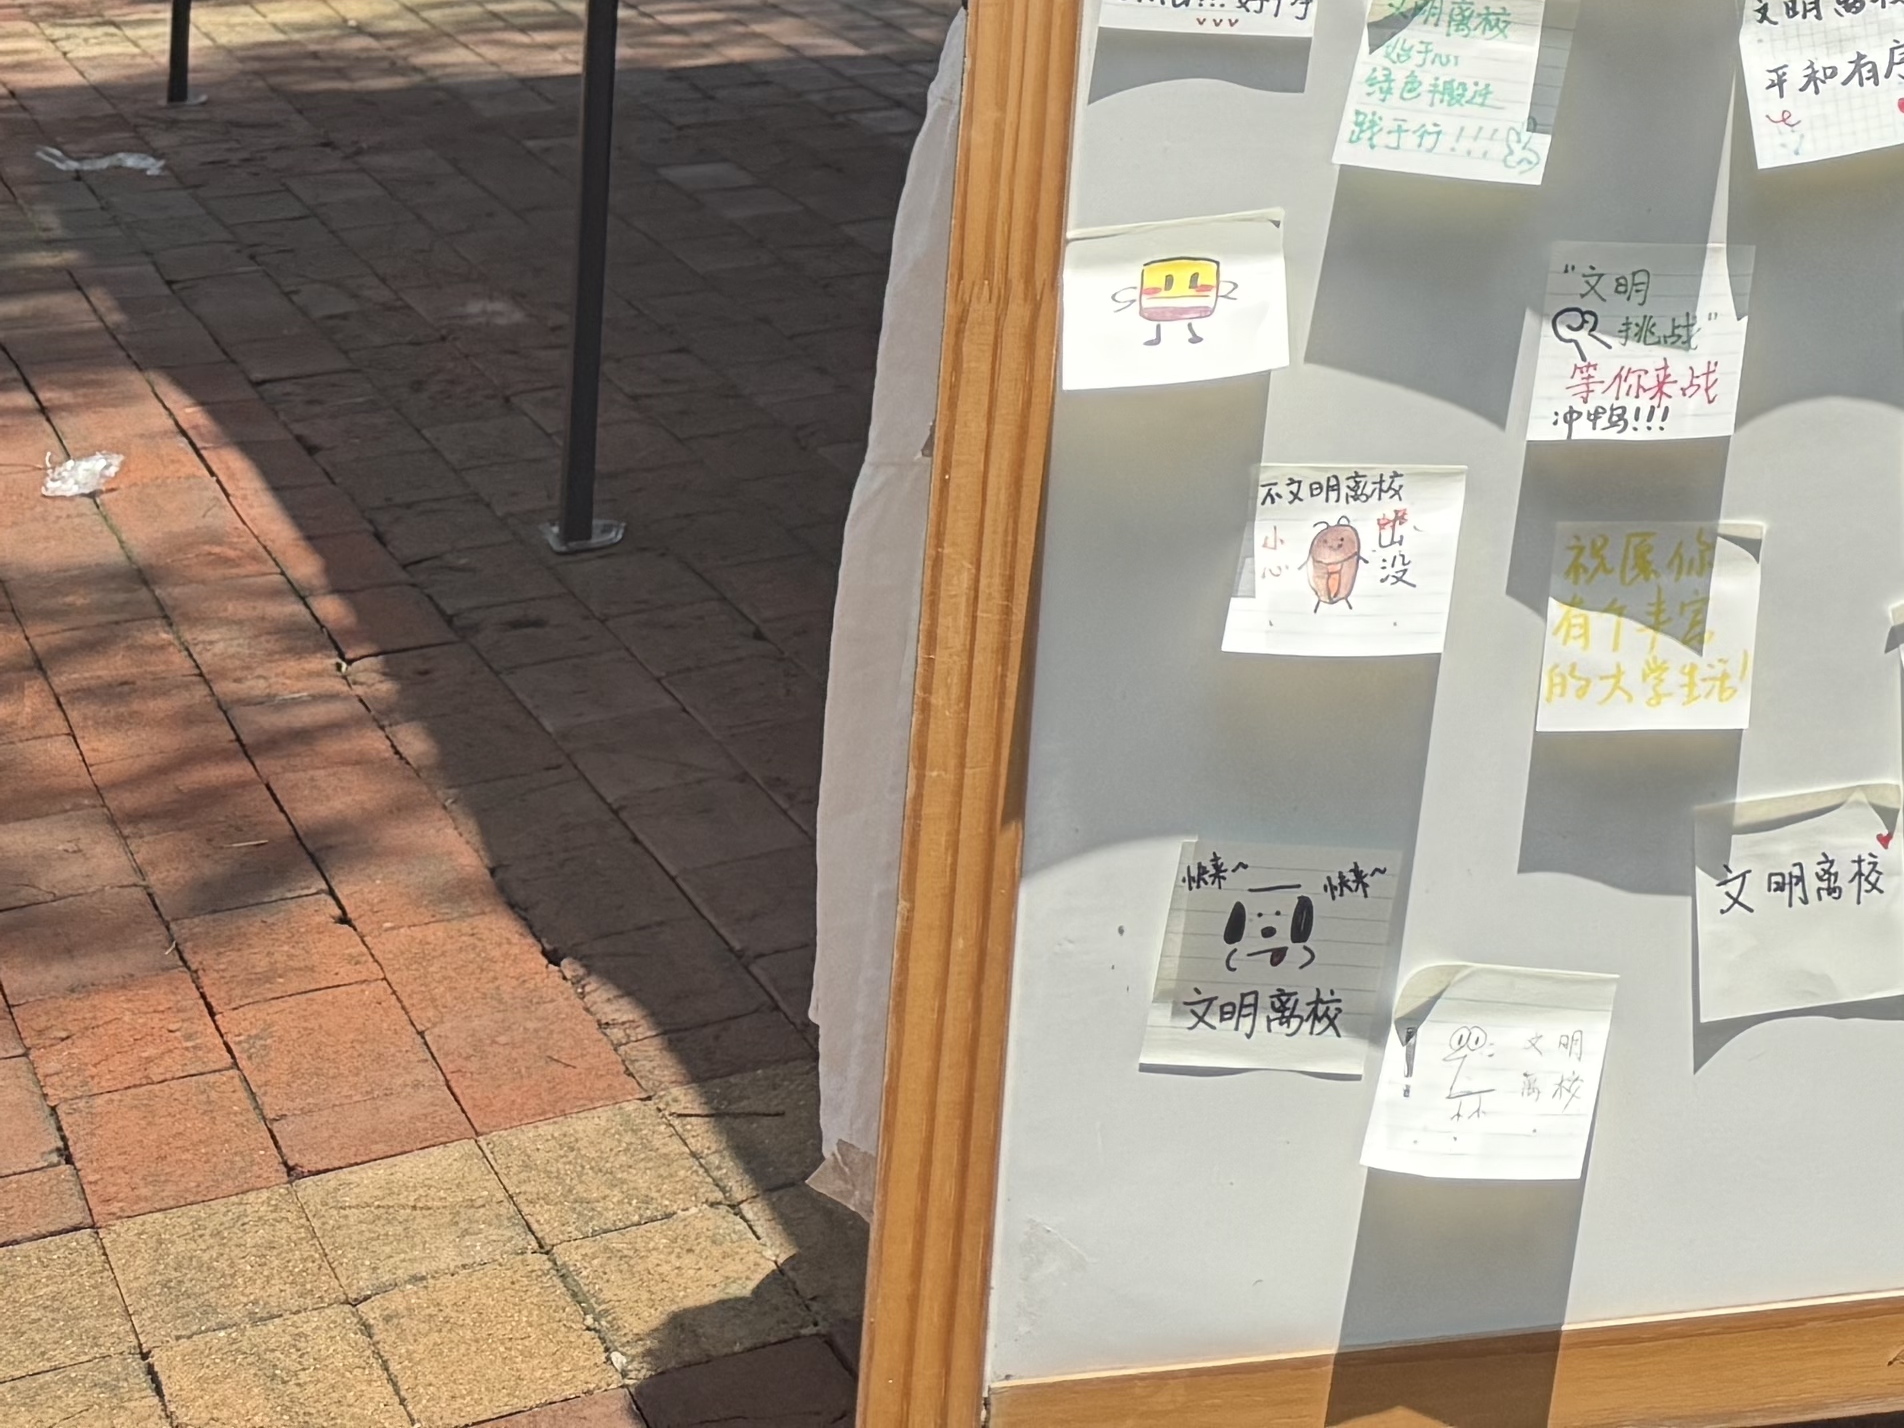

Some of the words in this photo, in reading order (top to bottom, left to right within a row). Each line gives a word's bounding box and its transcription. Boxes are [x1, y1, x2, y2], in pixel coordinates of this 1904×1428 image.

[1565, 356, 1720, 409] 等你来战
[1260, 470, 1405, 506] 不文明离校
[1716, 852, 1885, 915] 文明离校
[1182, 986, 1343, 1040] 文明离校
[1523, 1029, 1584, 1062] 文明
